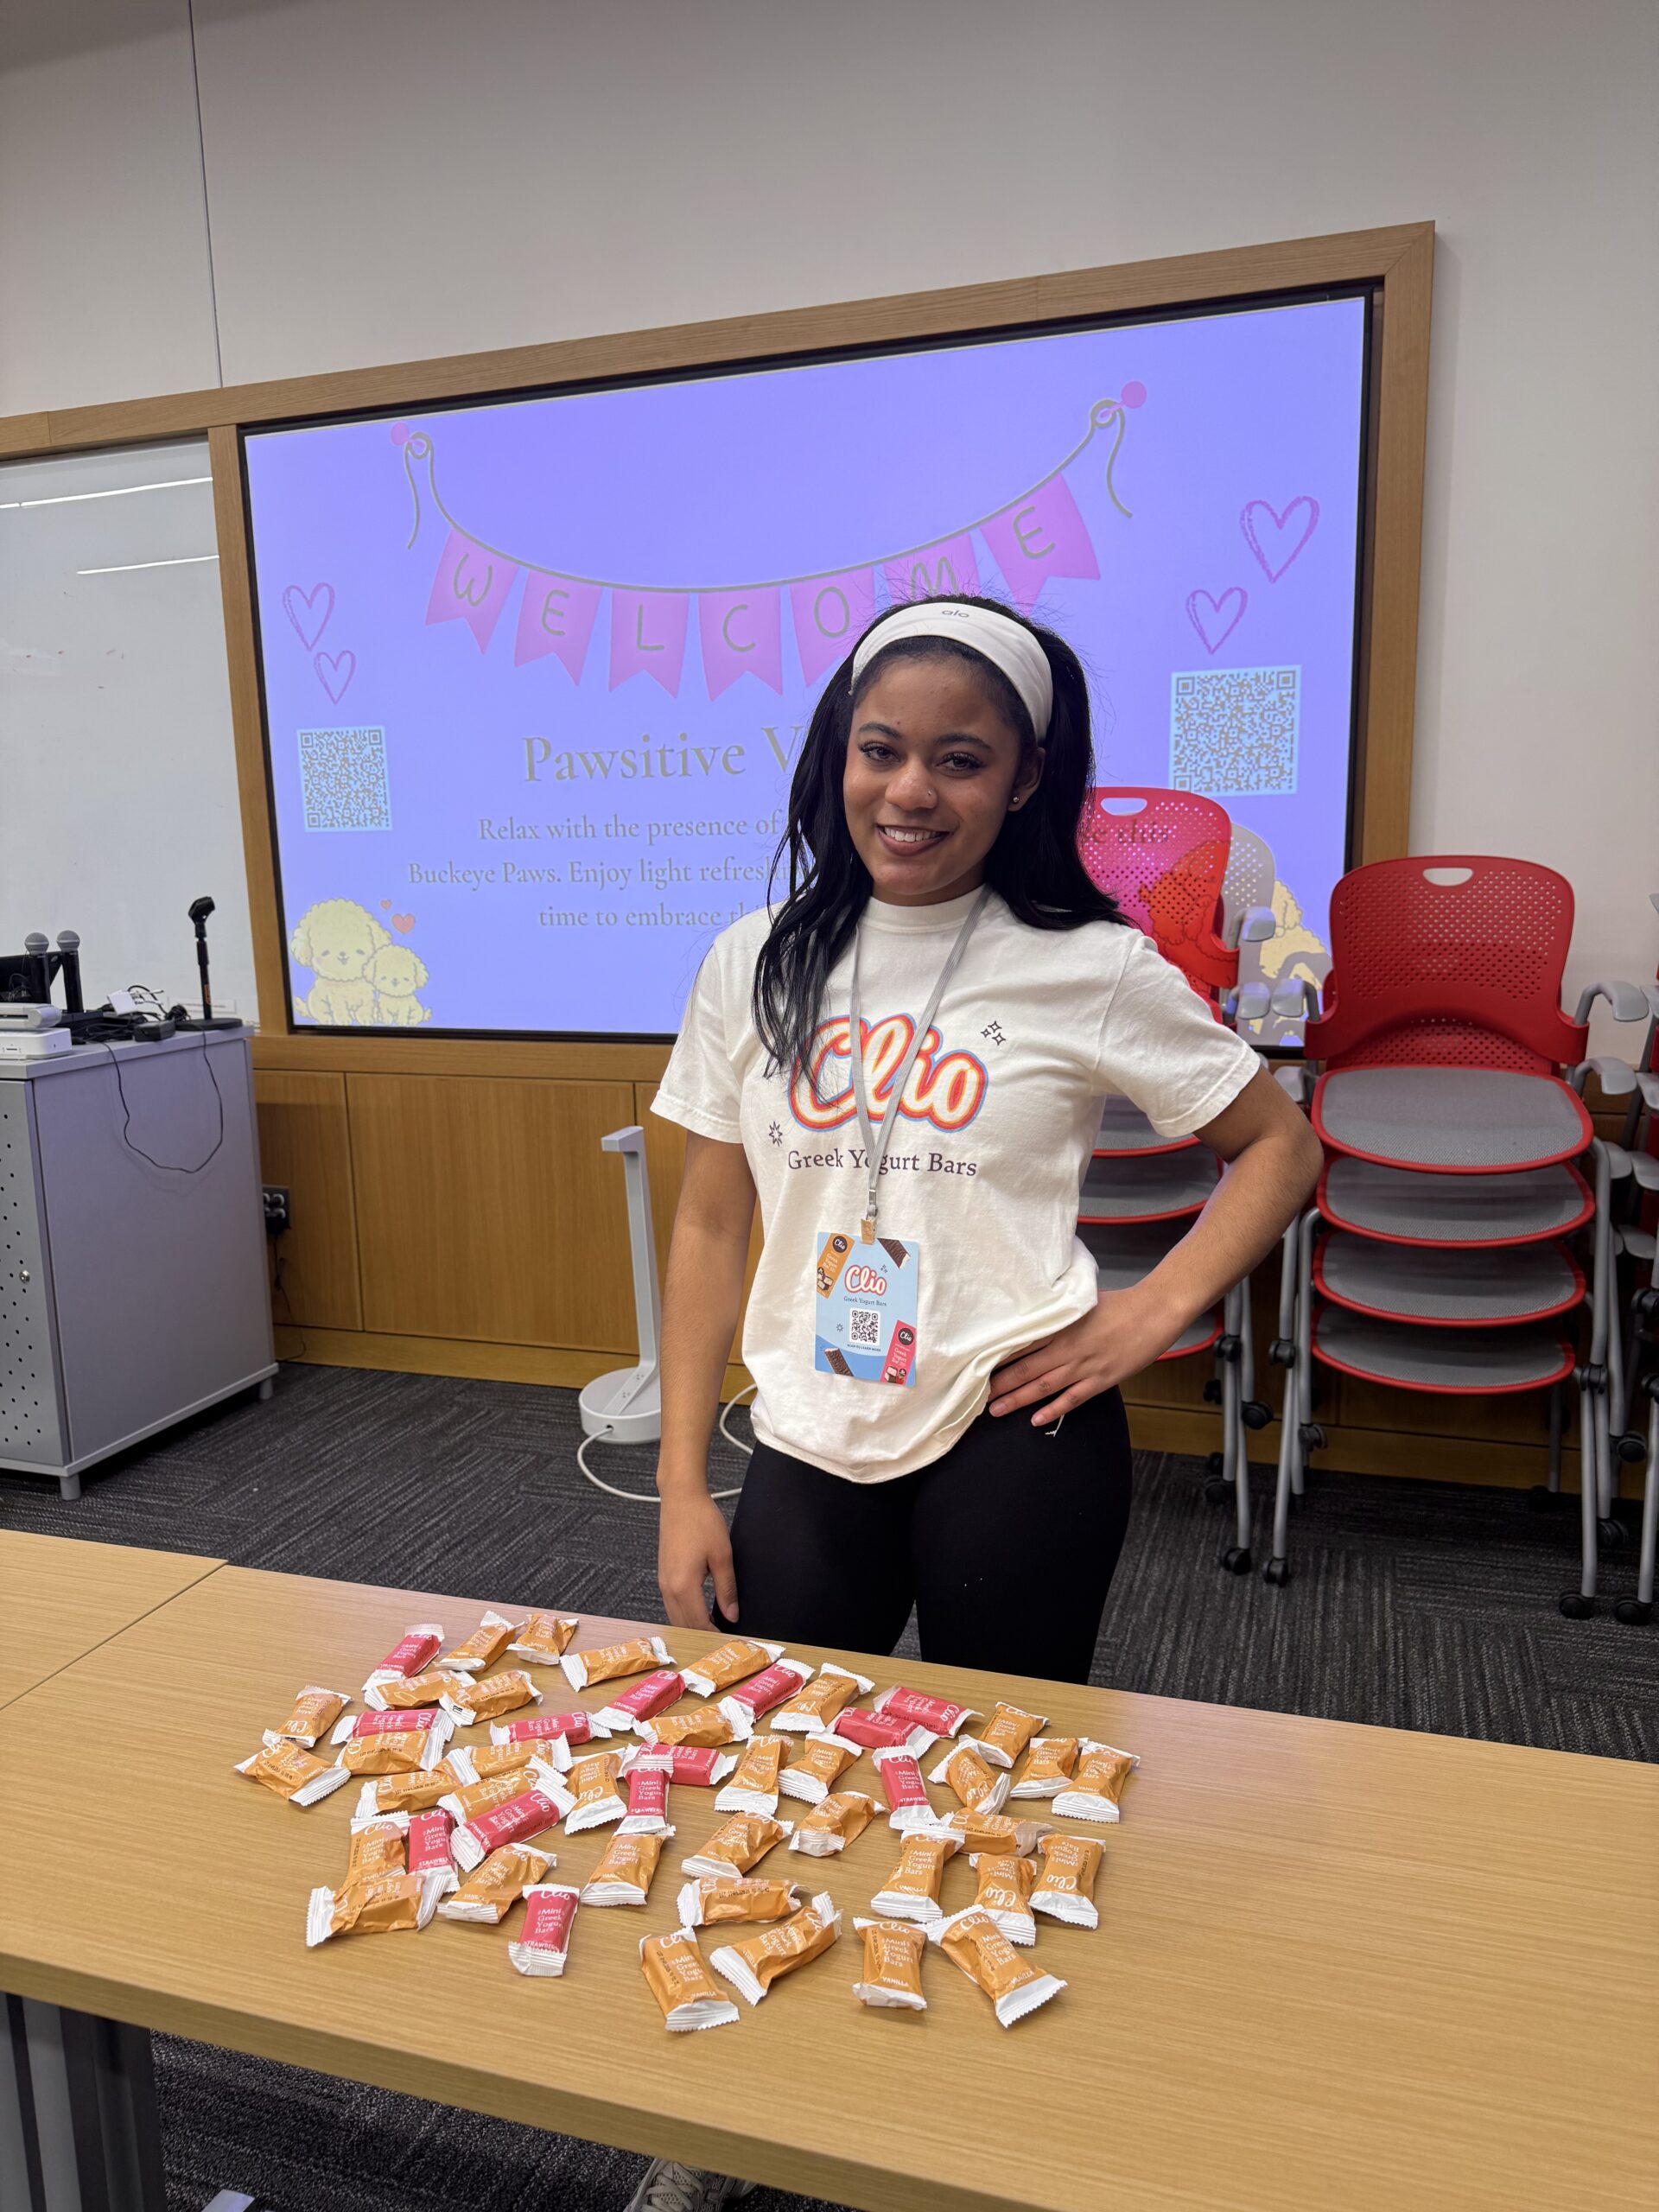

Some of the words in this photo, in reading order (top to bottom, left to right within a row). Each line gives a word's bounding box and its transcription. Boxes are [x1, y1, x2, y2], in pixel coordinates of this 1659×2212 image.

[454, 506, 1056, 652] WELCOME
[941, 607, 970, 619] alo
[521, 733, 747, 782] Pawsitive
[479, 816, 540, 841] Relax
[545, 815, 596, 839] with
[604, 814, 640, 837] the
[647, 818, 753, 845] presence
[755, 809, 783, 836] of
[408, 861, 495, 891] Buckeye
[503, 862, 562, 884] Paws.
[569, 861, 632, 891] Enjoy
[639, 858, 692, 891] light
[539, 906, 588, 927] time
[595, 908, 618, 927] to
[626, 903, 722, 927] embrace
[788, 1013, 988, 1133] Clio
[789, 1148, 843, 1169] Greek
[927, 1153, 977, 1176] Bars
[844, 1264, 887, 1296] Clio
[899, 1331, 912, 1342] Clio
[774, 1666, 795, 1677] Clio
[571, 1712, 586, 1727] Clio
[940, 1704, 960, 1721] Clio
[531, 1793, 550, 1812] Clio
[365, 1821, 393, 1835] Clio
[426, 1826, 445, 1834] Mini
[424, 1843, 443, 1852] Bars
[425, 1838, 446, 1847] Yogu
[907, 1861, 936, 1871] Yogurt
[908, 1855, 933, 1864] Greek
[904, 1867, 923, 1876] Bars
[1046, 1874, 1077, 1891] Clio
[986, 1886, 1017, 1908] Clio
[880, 1922, 910, 1934] Clio
[960, 1916, 989, 1930] Clio
[760, 1934, 774, 1950] Bars
[884, 1944, 909, 1955] Greek
[884, 1949, 913, 1963] Yogurt
[991, 1946, 1015, 1958] Yogu
[884, 1956, 903, 1967] Bars
[995, 1955, 1017, 1966] Bars
[882, 1976, 909, 1986] VANILLA
